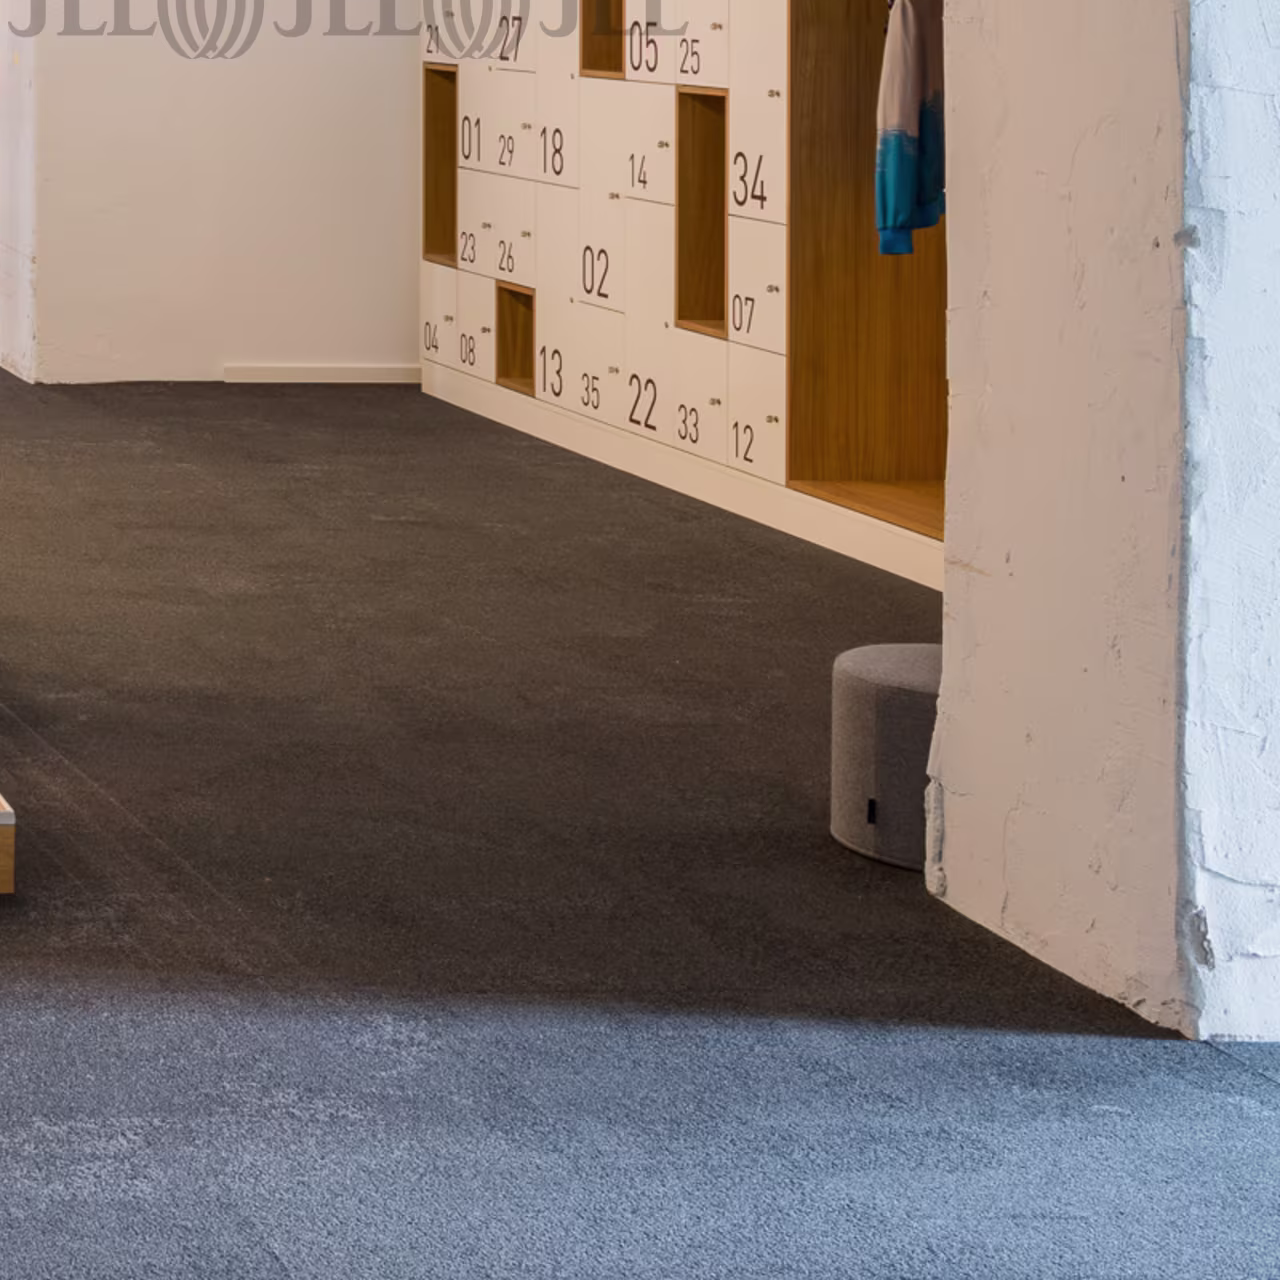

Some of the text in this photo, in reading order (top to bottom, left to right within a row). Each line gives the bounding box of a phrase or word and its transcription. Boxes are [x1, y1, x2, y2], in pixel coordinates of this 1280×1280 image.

[426, 24, 440, 55] 21
[499, 15, 523, 63] 27
[629, 20, 658, 73] 05
[679, 37, 701, 76] 25
[461, 115, 481, 162] 01
[498, 133, 515, 167] 29
[539, 125, 564, 177] 18
[628, 153, 648, 190] 14
[732, 151, 768, 211] 34
[460, 230, 477, 265] 23
[498, 239, 515, 274] 26
[582, 244, 609, 300] 02
[732, 293, 756, 334] 07
[423, 321, 440, 353] 04
[460, 332, 476, 367] 08
[539, 345, 564, 400] 13
[580, 372, 601, 411] 35
[628, 373, 658, 432] 22
[677, 403, 700, 445] 33
[732, 420, 755, 464] 12
